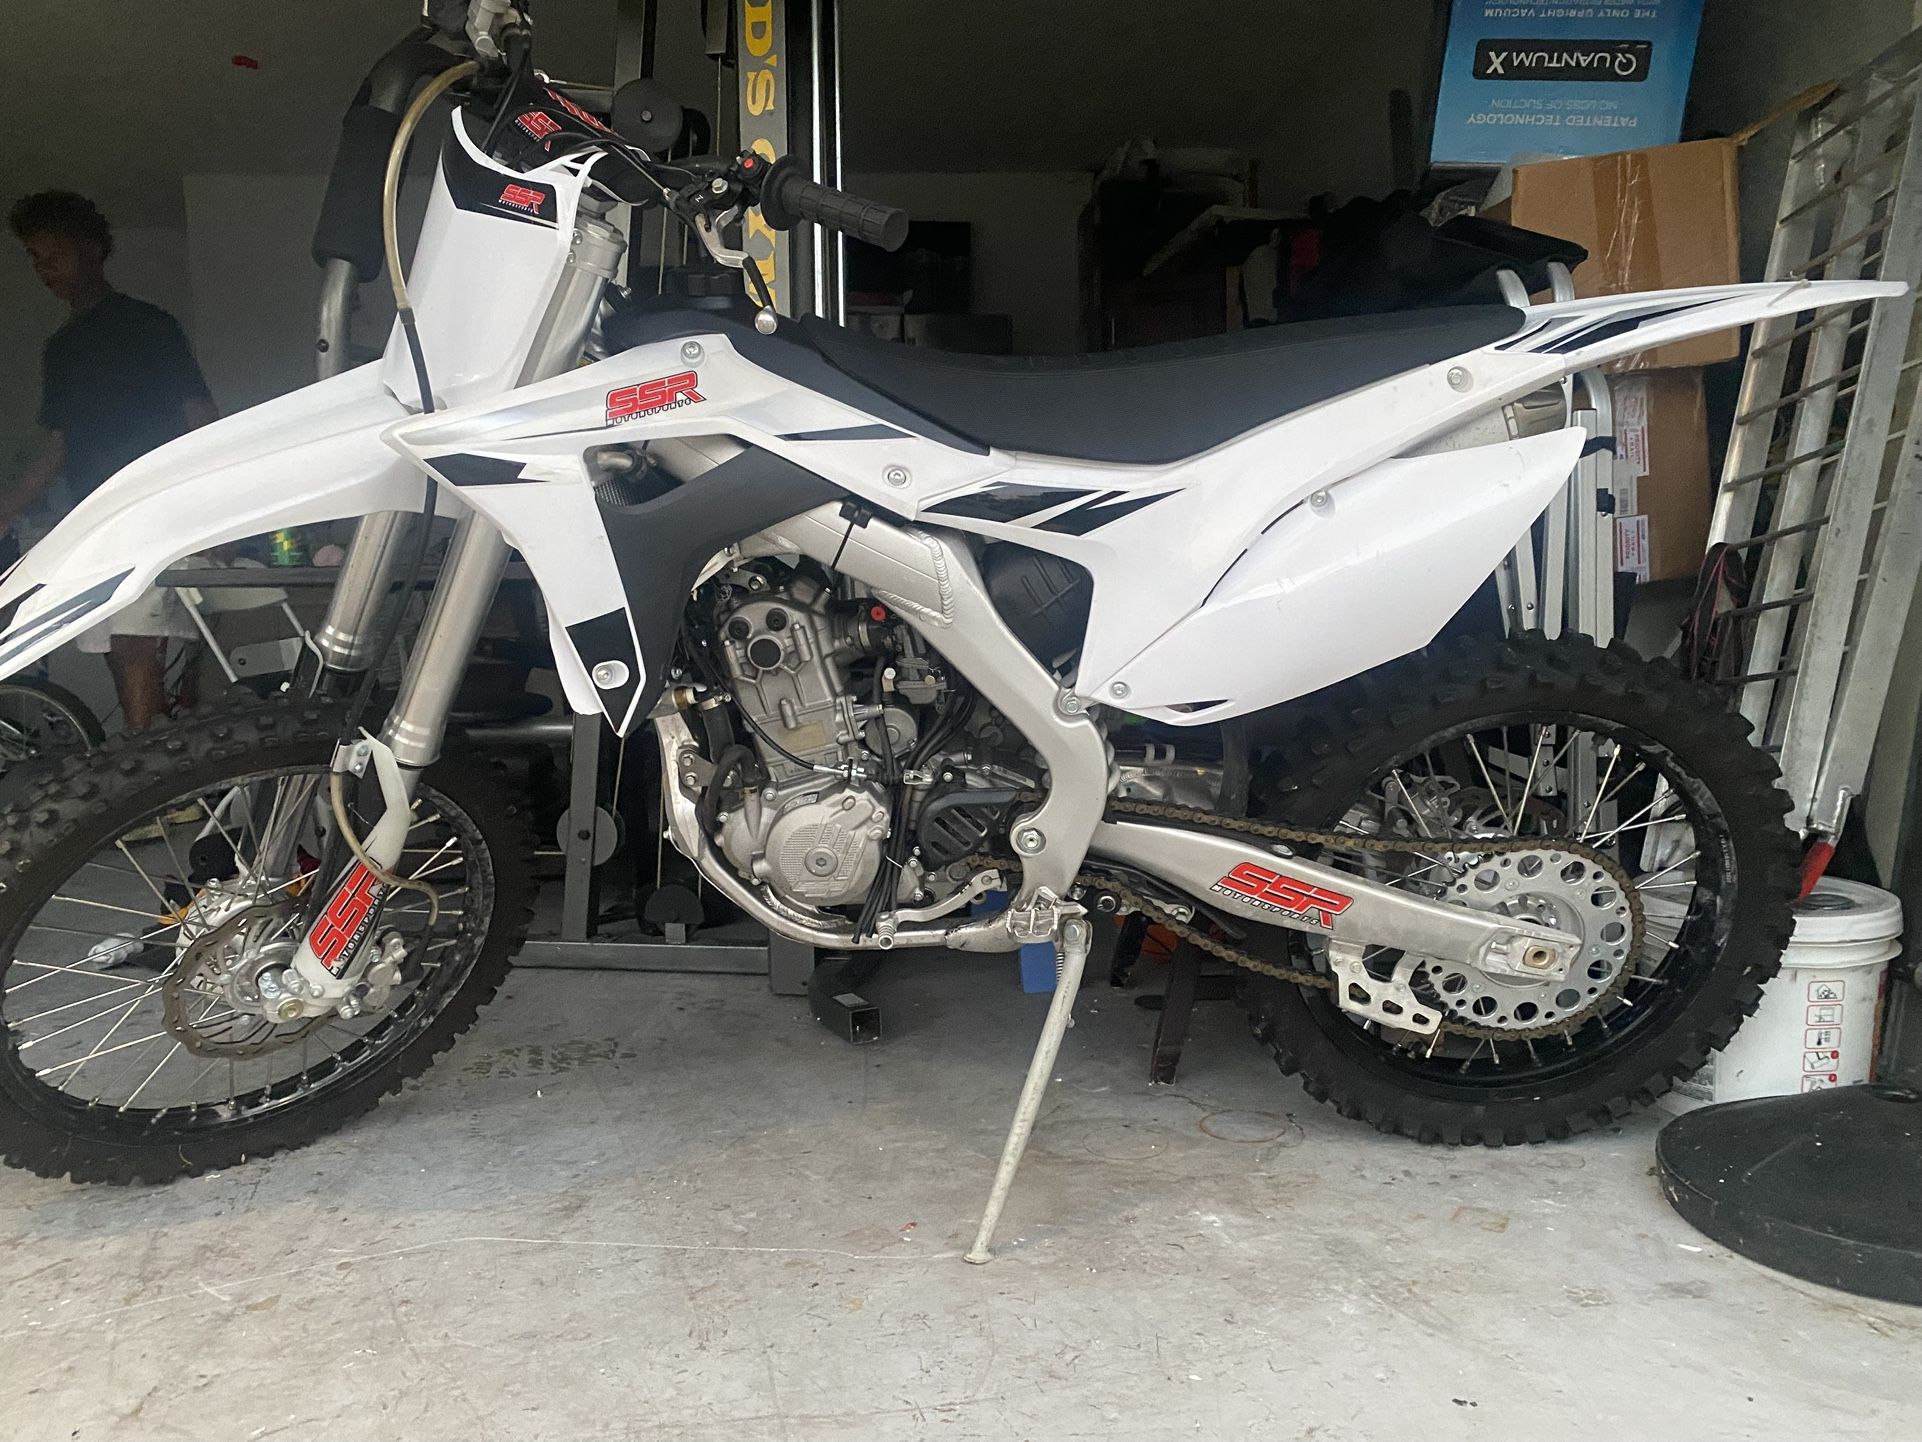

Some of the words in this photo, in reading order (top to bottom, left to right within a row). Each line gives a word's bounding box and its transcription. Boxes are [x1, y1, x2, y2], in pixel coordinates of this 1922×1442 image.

[1484, 8, 1536, 17] VACUUM
[1539, 9, 1594, 18] UPRIGHT
[1598, 9, 1629, 18] ONLY
[1634, 9, 1657, 18] THE
[1486, 51, 1509, 75] X
[1512, 52, 1637, 76] QUANTUM
[1490, 98, 1543, 110] SUCTION
[1466, 113, 1561, 127] TECHNOLOGY
[1566, 115, 1638, 128] PATENTED
[500, 183, 546, 214] SSR
[606, 370, 706, 420] SSR
[1218, 862, 1354, 930] SSR
[1210, 883, 1321, 926] MOTORSPORTS
